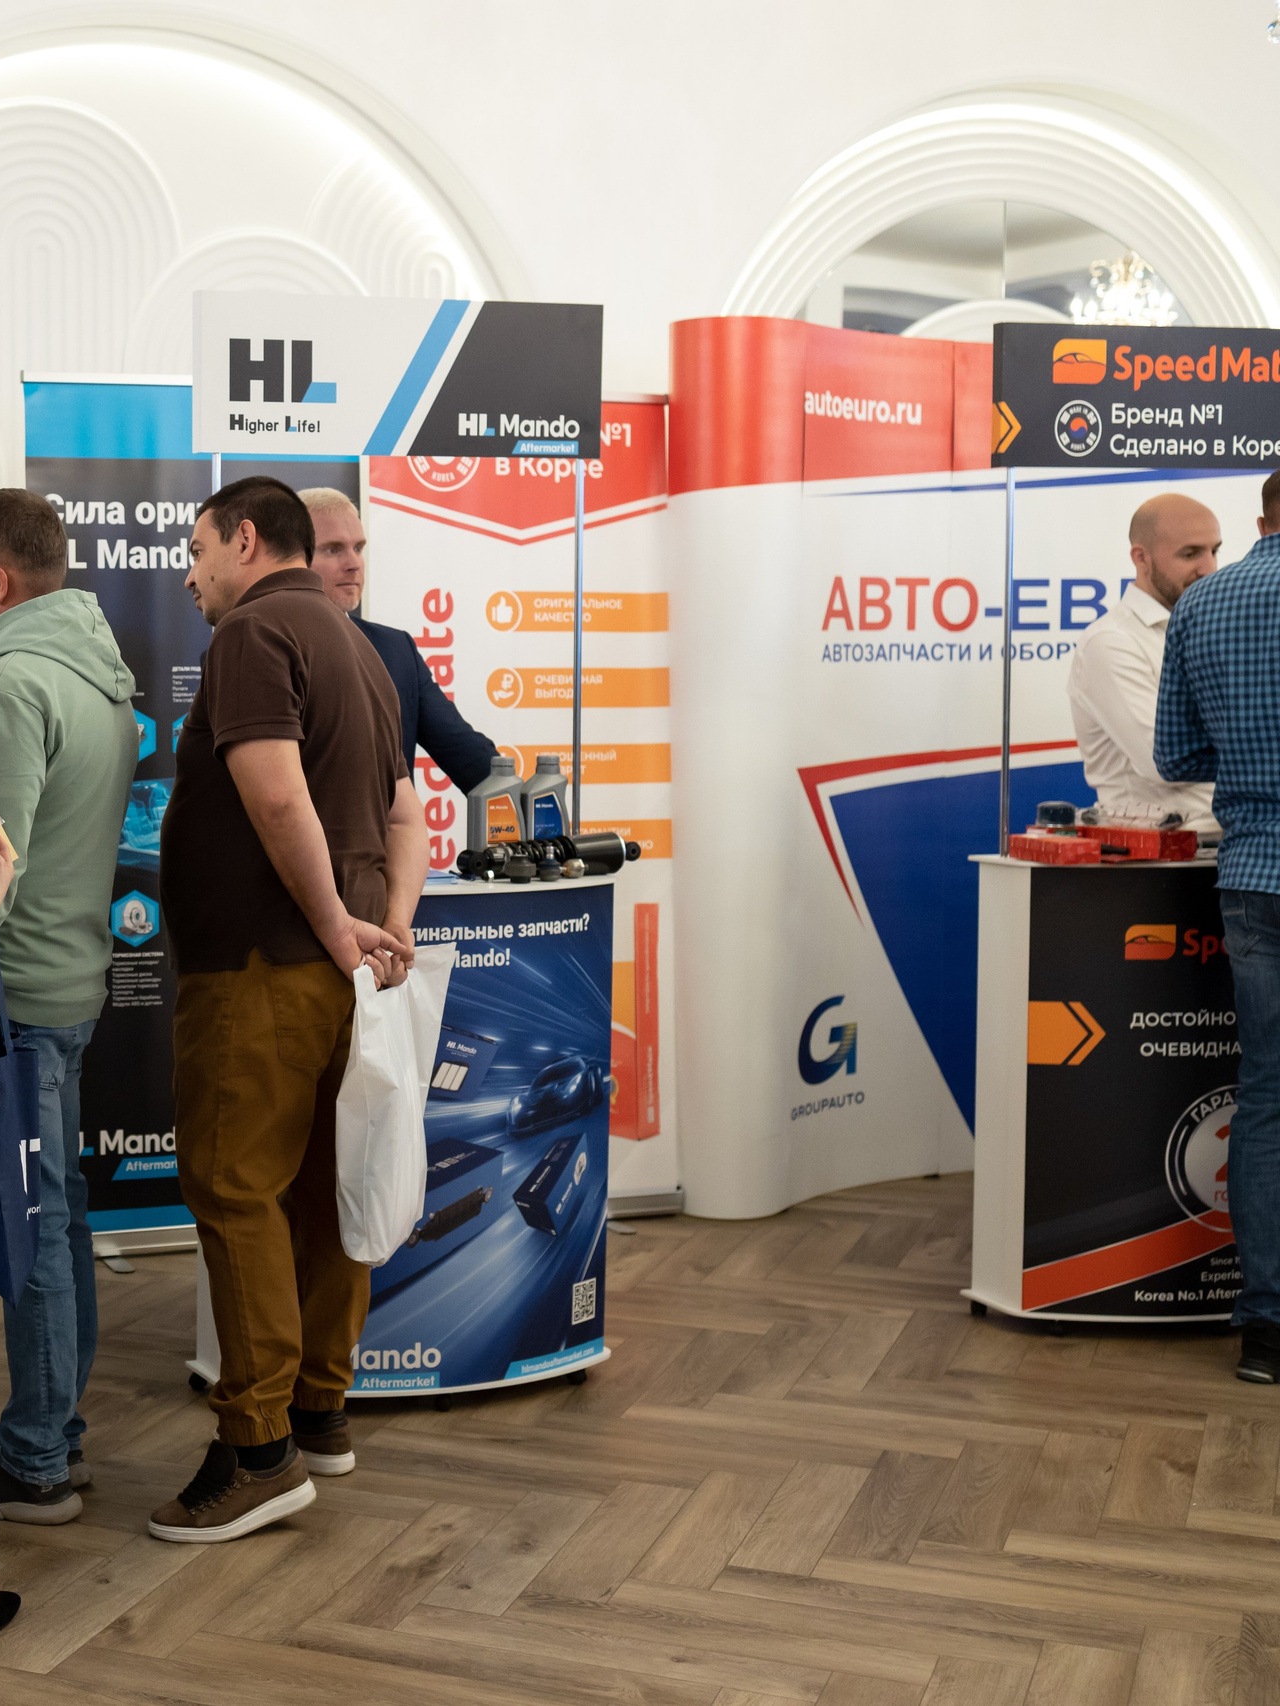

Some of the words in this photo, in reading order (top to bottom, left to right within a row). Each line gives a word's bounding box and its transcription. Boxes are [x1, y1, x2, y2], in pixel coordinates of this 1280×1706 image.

[229, 338, 337, 404] HL
[1113, 345, 1280, 391] SpeedMat
[804, 390, 922, 426] autoeuro.ru
[1111, 403, 1184, 427] Бренд
[1190, 404, 1223, 425] №1
[229, 414, 279, 434] Higher
[285, 416, 320, 433] Life!
[458, 413, 495, 436] HL
[500, 414, 580, 439] Mando
[519, 443, 576, 453] Aftermarket
[1110, 434, 1207, 456] Сделано
[1213, 438, 1225, 456] в
[135, 501, 204, 533] ори
[97, 537, 195, 569] Mand
[533, 598, 623, 610] ОРИГИАЛЬНОЕ
[534, 612, 592, 622] КАЧЕСТО
[822, 642, 974, 662] АВТОЗАПЧАСТИ
[979, 643, 993, 660] И
[1001, 642, 1077, 661] ОБОР
[534, 674, 602, 685] ОЧЕВИНАЯ
[535, 688, 575, 700] ВЫГОД
[518, 913, 590, 938] запчасти?
[1130, 1009, 1236, 1029] ДОСТОЙНО
[1140, 1041, 1242, 1058] ОЧЕВИДНА
[791, 1091, 865, 1120] GROUPAUTO
[100, 1126, 176, 1156] Mand
[1200, 1270, 1244, 1283] Experie
[1134, 1290, 1174, 1302] Korea
[361, 1376, 435, 1389] Aftermarket
